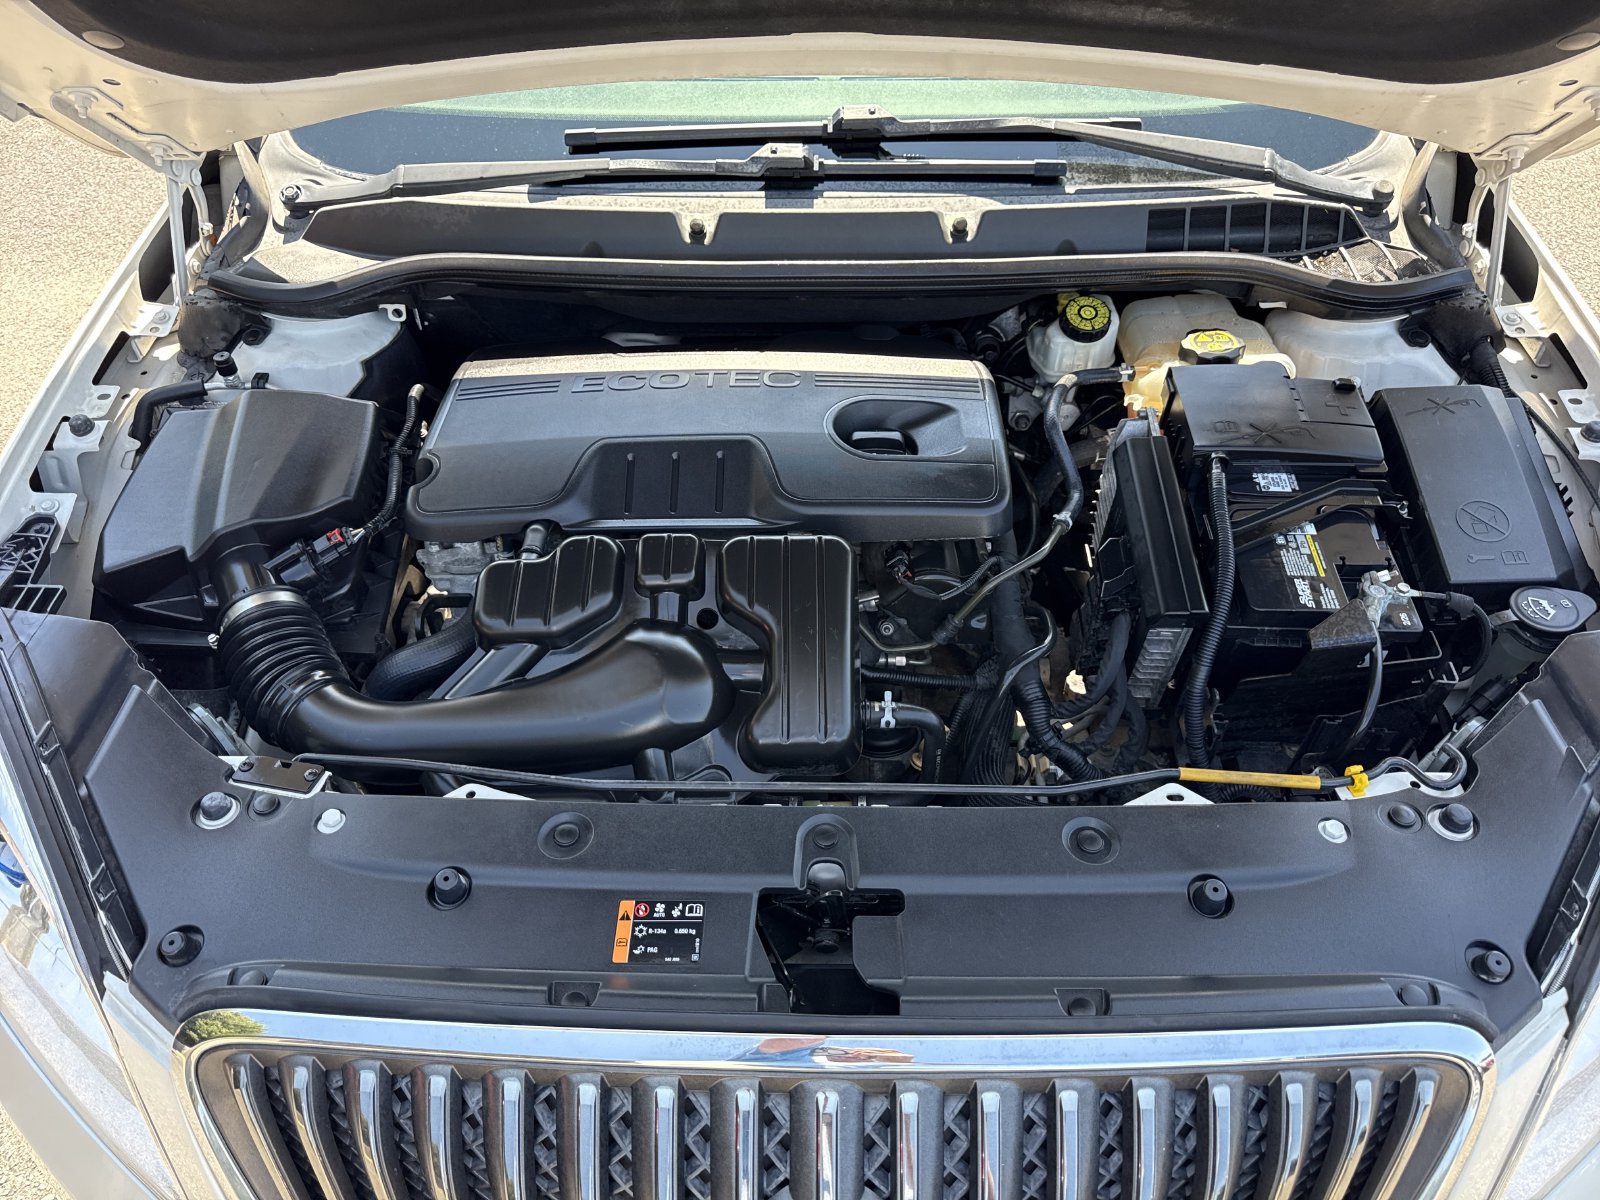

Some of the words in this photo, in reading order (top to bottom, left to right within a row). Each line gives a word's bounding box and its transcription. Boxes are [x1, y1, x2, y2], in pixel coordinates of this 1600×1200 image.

[571, 371, 801, 393] ECOTEC
[1294, 578, 1305, 605] SUPER
[1301, 579, 1316, 609] START
